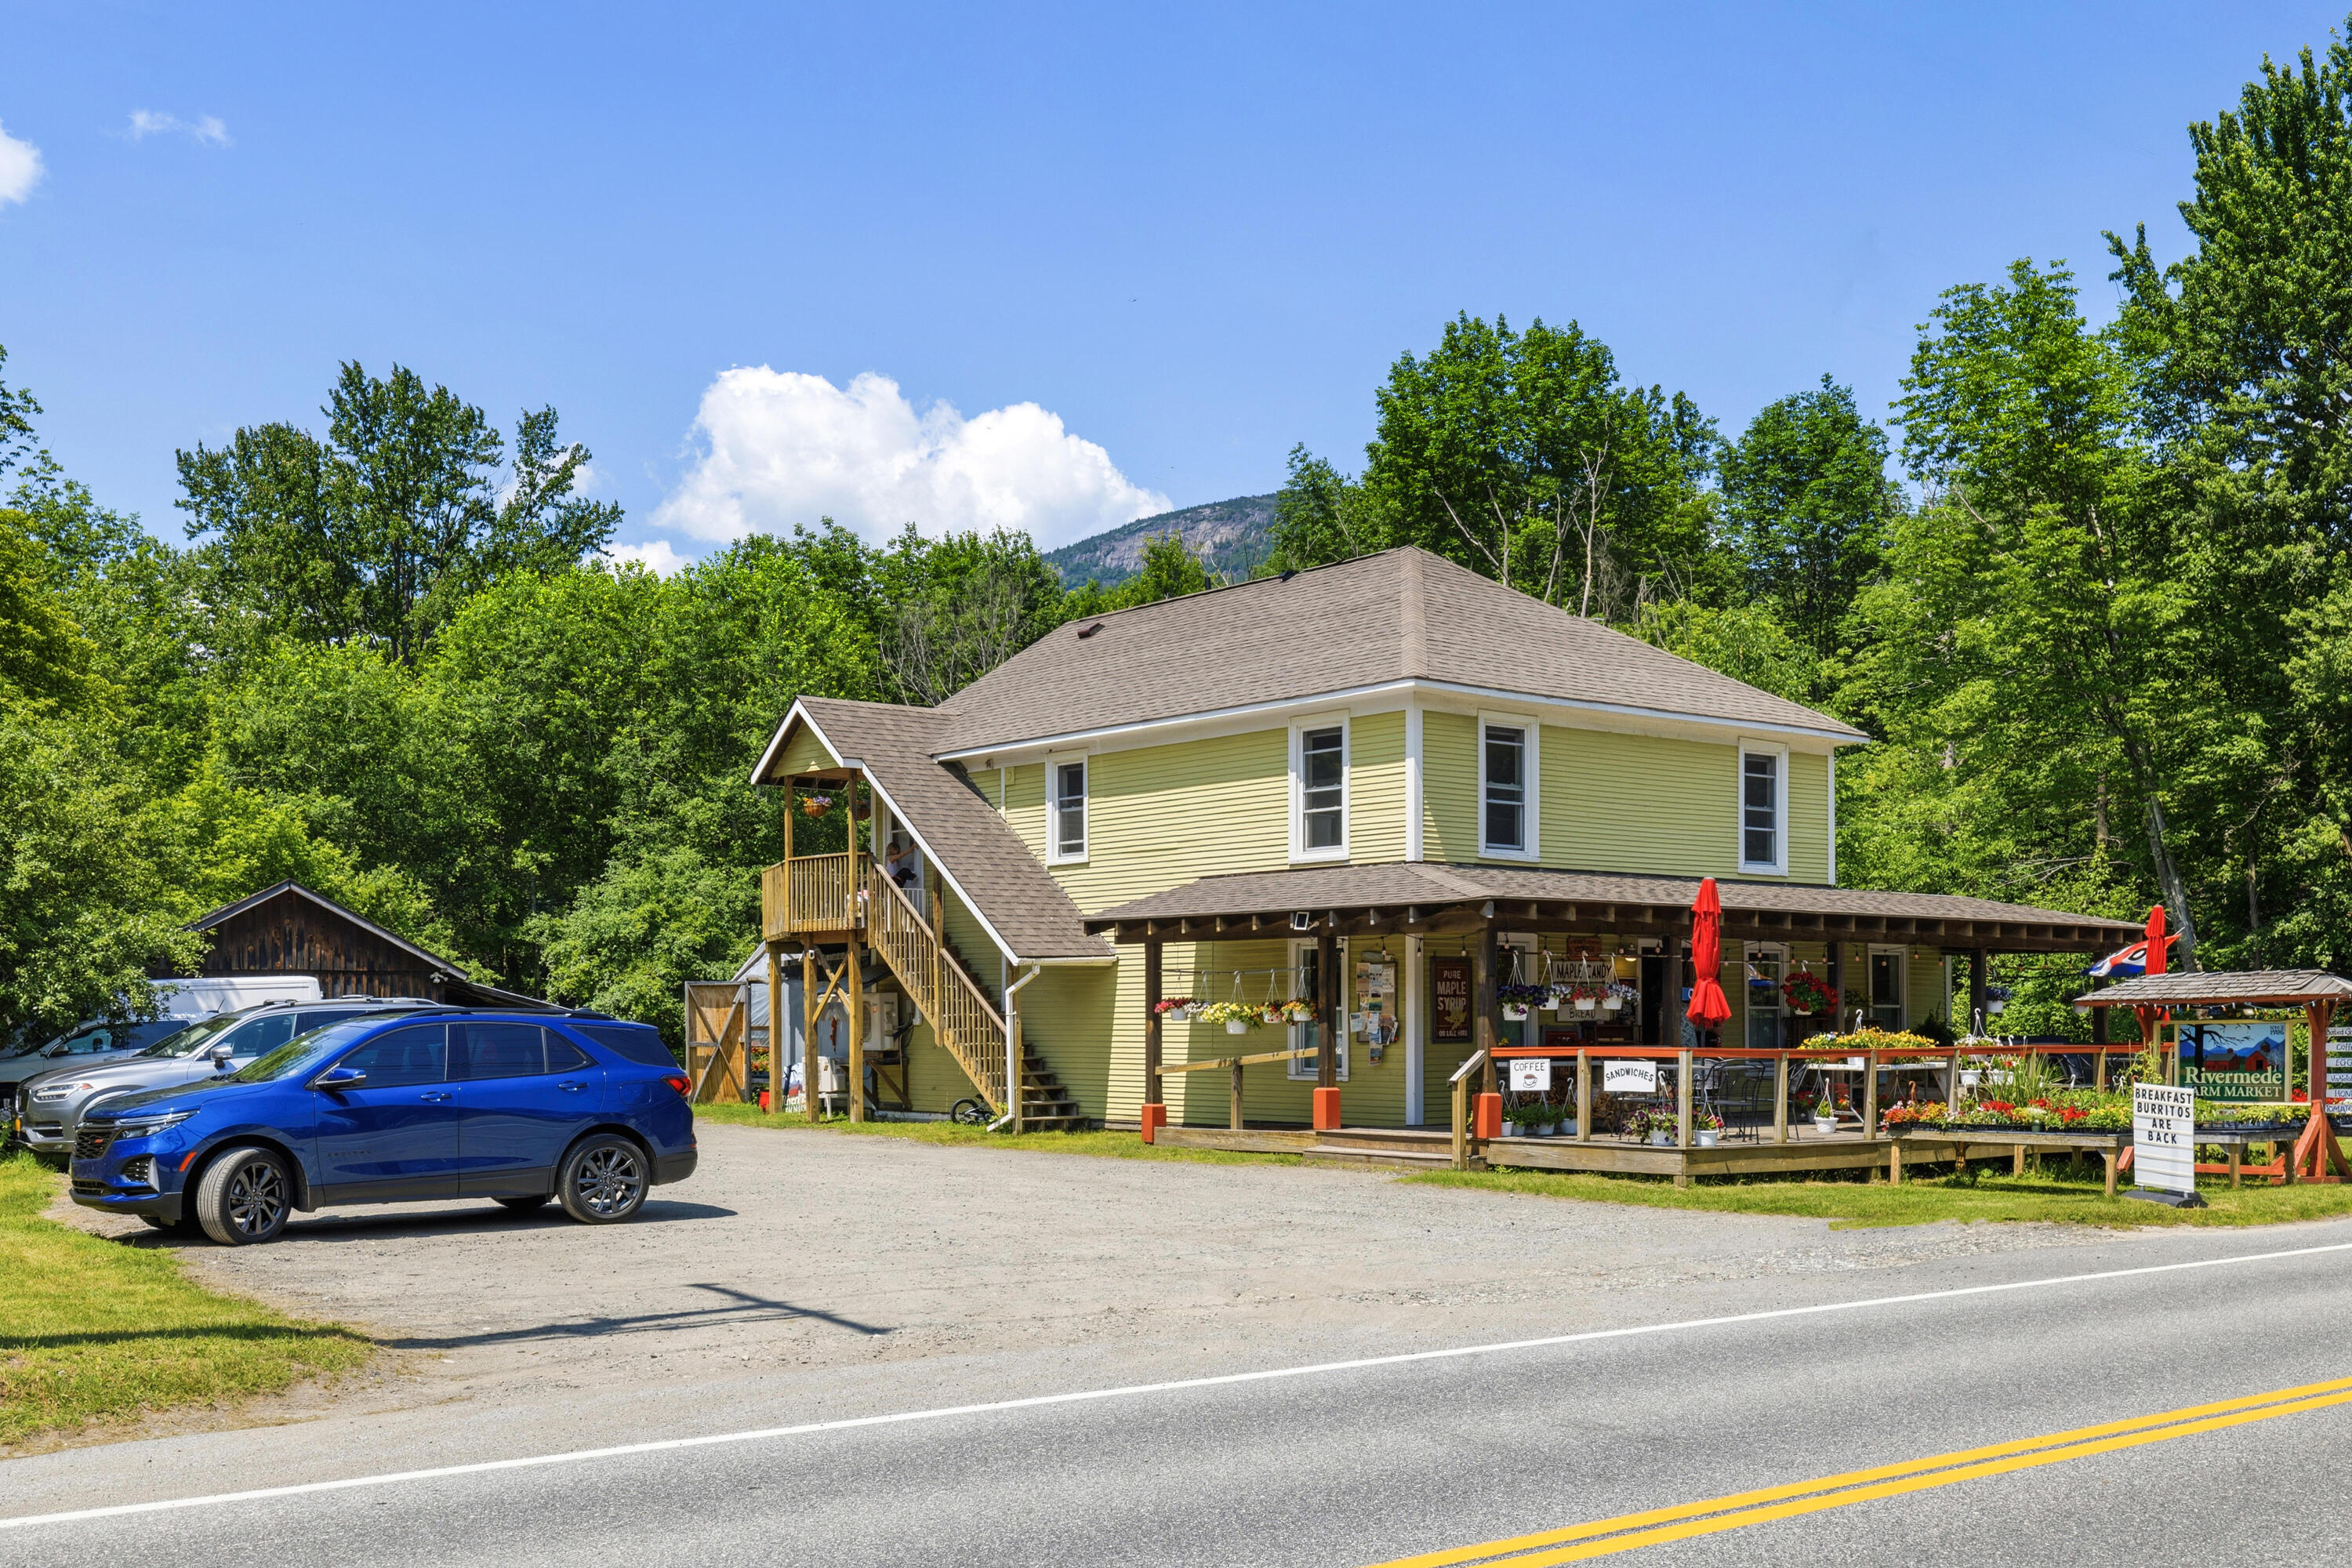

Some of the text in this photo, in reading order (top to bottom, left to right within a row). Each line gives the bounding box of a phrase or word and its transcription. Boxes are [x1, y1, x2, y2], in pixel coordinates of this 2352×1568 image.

[1443, 971, 1461, 979] PURE
[1556, 962, 1613, 978] MAPLE CANDY
[1437, 982, 1466, 994] MAPLE
[1437, 997, 1466, 1011] SYRUP
[1570, 1008, 1596, 1018] BREAD
[1514, 1062, 1545, 1072] COFFEE
[1606, 1067, 1654, 1082] SANDWICHES
[2184, 1065, 2282, 1084] Rivermede
[2136, 1088, 2192, 1104] BREAKFAST
[2191, 1086, 2281, 1098] ARM MARKET
[2137, 1102, 2190, 1118] BURRITOS
[2152, 1118, 2172, 1130] ARE
[2148, 1131, 2177, 1144] BACK
